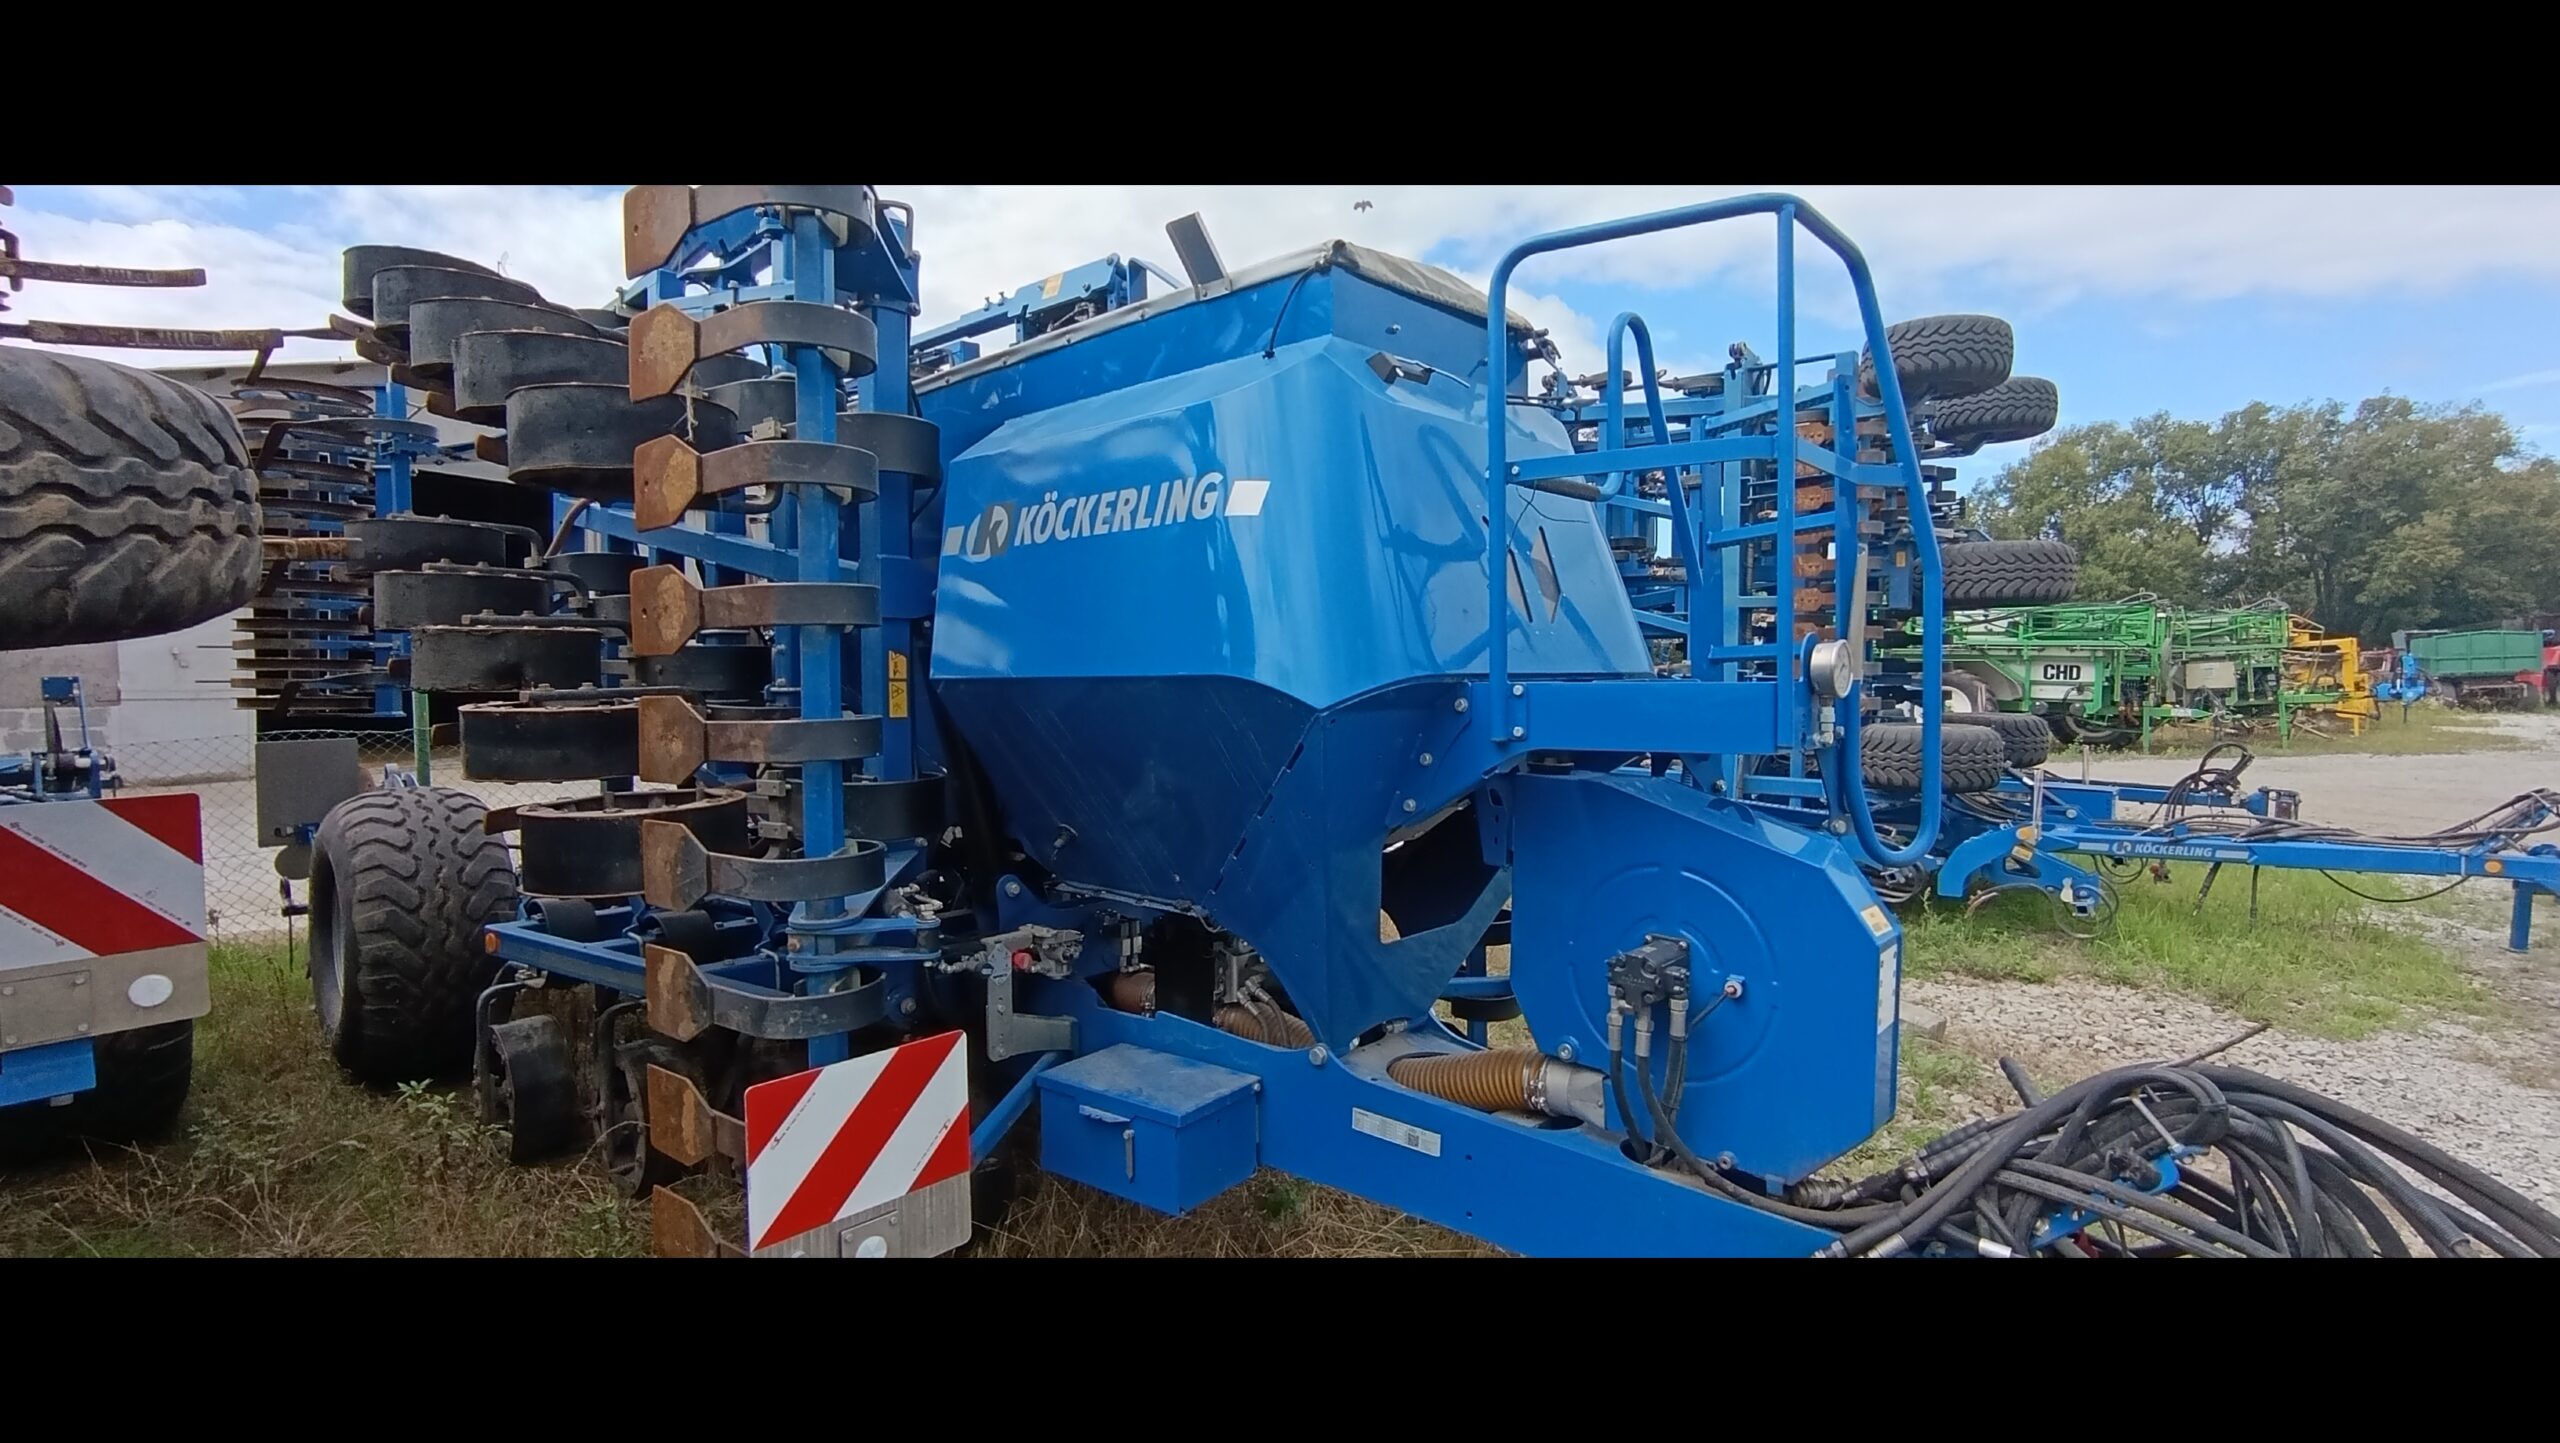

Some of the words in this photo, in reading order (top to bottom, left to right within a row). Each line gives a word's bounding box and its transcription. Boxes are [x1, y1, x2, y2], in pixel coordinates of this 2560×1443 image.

[1013, 471, 1224, 547] KÖCKERLING
[2043, 664, 2081, 681] CHD
[2135, 842, 2213, 857] KÖCKERLING
